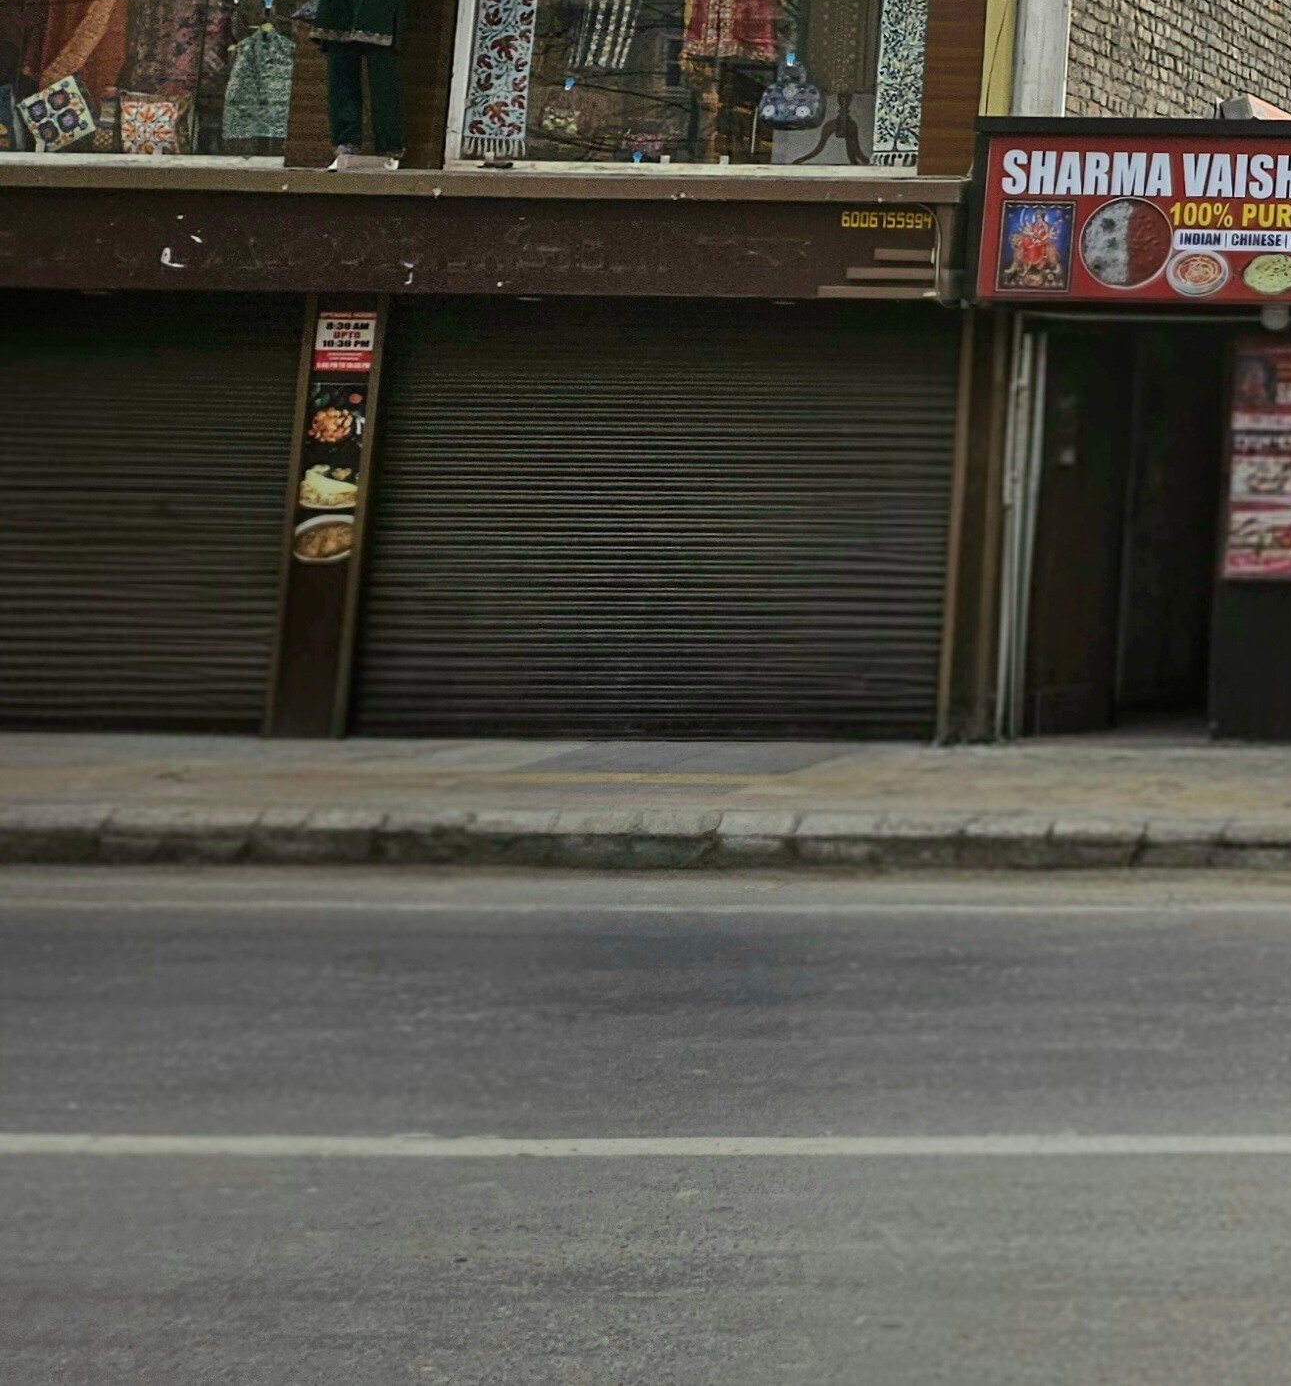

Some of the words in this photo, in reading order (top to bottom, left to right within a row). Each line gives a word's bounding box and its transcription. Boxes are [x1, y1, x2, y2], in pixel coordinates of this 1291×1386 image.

[1001, 148, 1172, 197] SHARMA
[841, 211, 932, 229] 6006755994
[1169, 201, 1233, 229] 100%
[1179, 232, 1221, 247] INDIAN
[1231, 233, 1282, 248] CHINESE
[353, 322, 370, 330] AM
